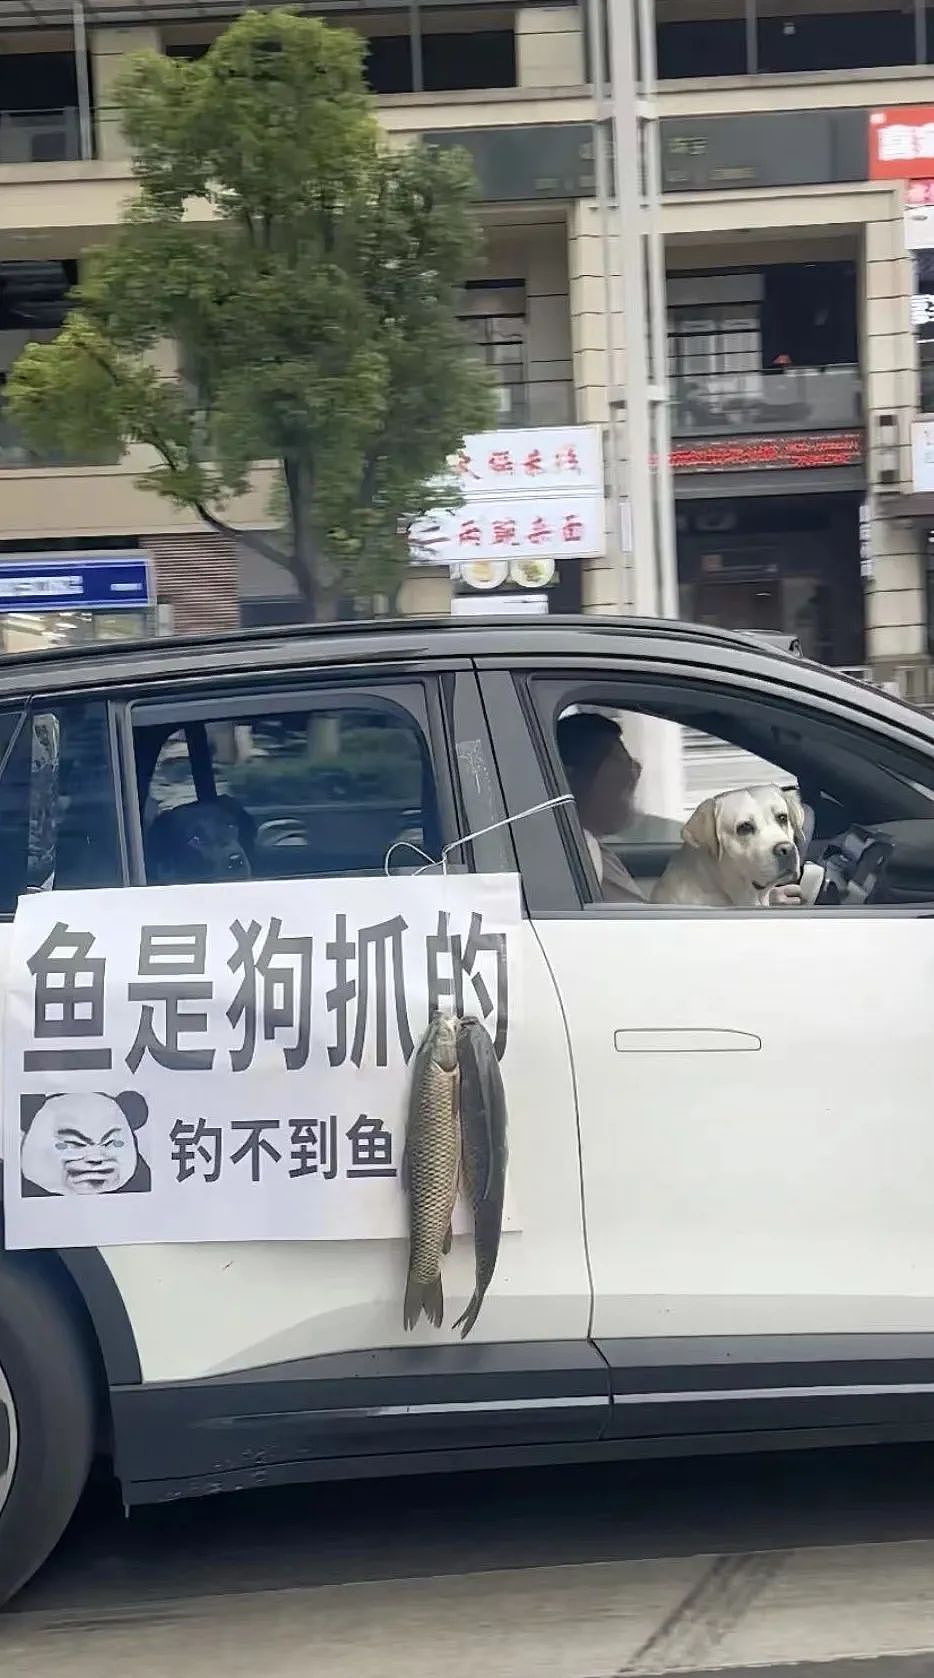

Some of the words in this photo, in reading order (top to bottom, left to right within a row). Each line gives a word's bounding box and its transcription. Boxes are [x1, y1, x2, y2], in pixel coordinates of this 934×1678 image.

[23, 911, 508, 1074] 鱼是狗抓的
[169, 1113, 398, 1182] 钓不到鱼
